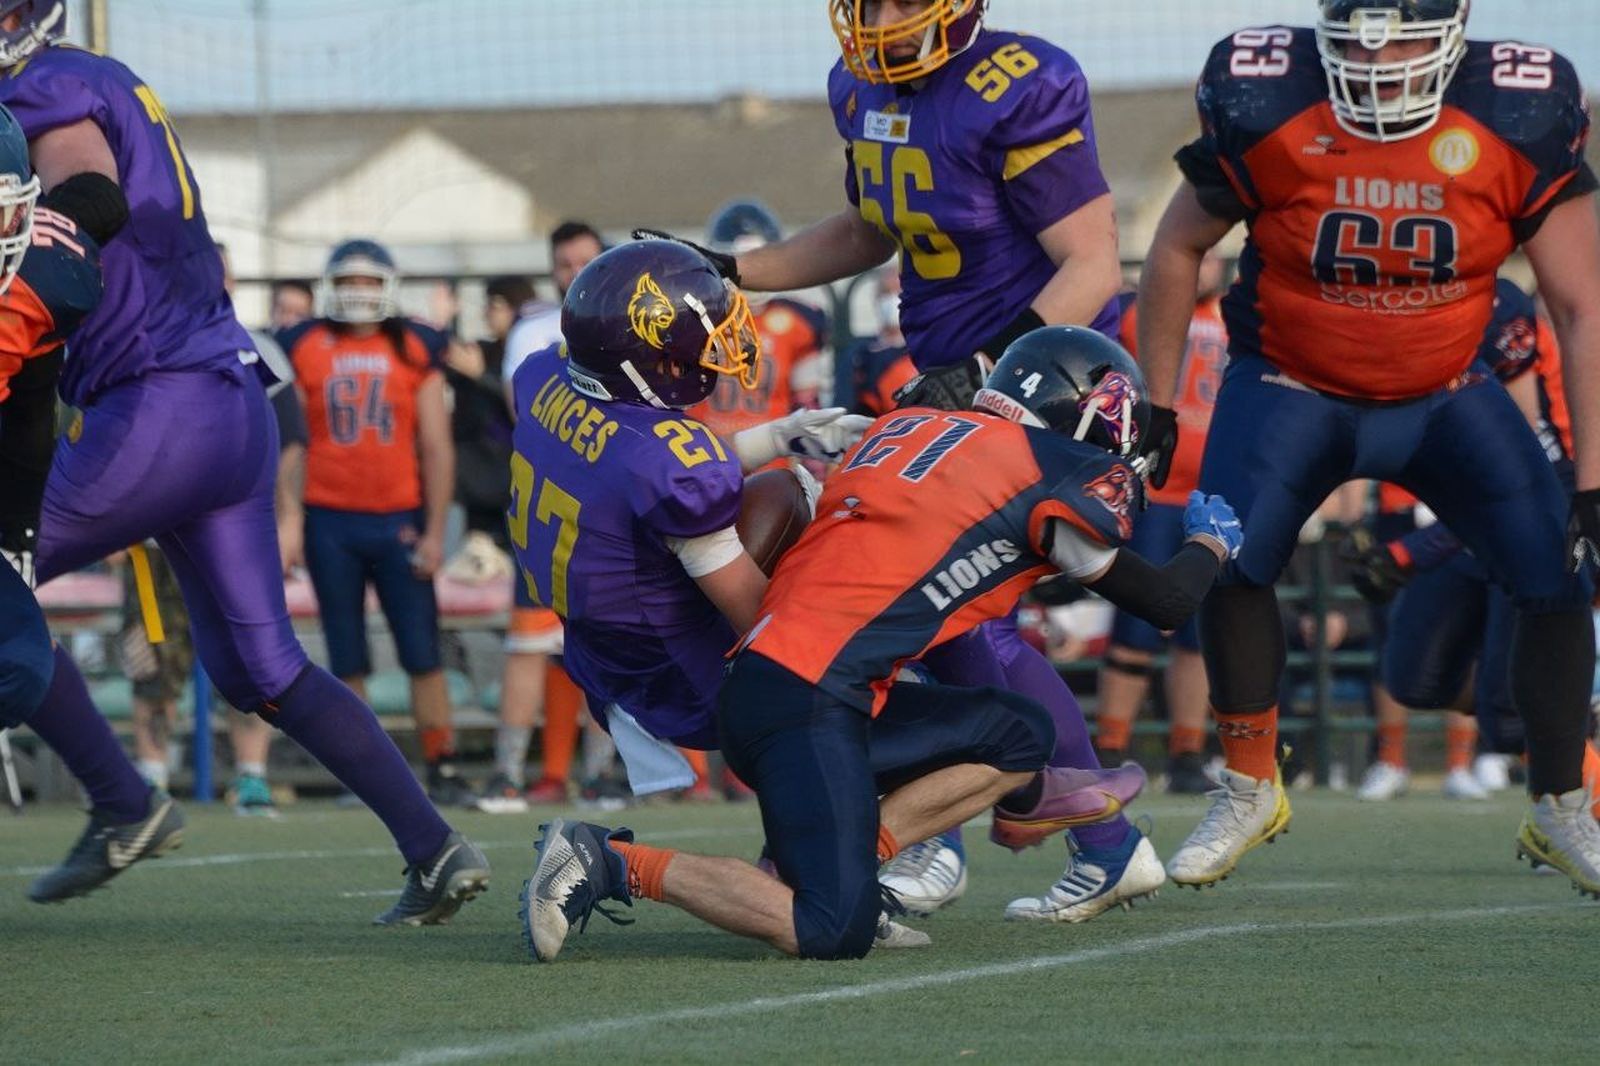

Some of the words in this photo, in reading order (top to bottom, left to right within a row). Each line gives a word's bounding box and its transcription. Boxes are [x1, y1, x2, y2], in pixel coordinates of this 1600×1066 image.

[964, 43, 1039, 102] 56
[853, 140, 961, 280] 56
[1335, 176, 1444, 211] LIONS
[1312, 209, 1458, 286] 63
[323, 376, 395, 445] 64
[530, 374, 619, 463] LINCES
[1020, 372, 1043, 398] 4
[653, 419, 728, 469] 27
[507, 450, 581, 618] 27
[921, 539, 1021, 612] LIONS
